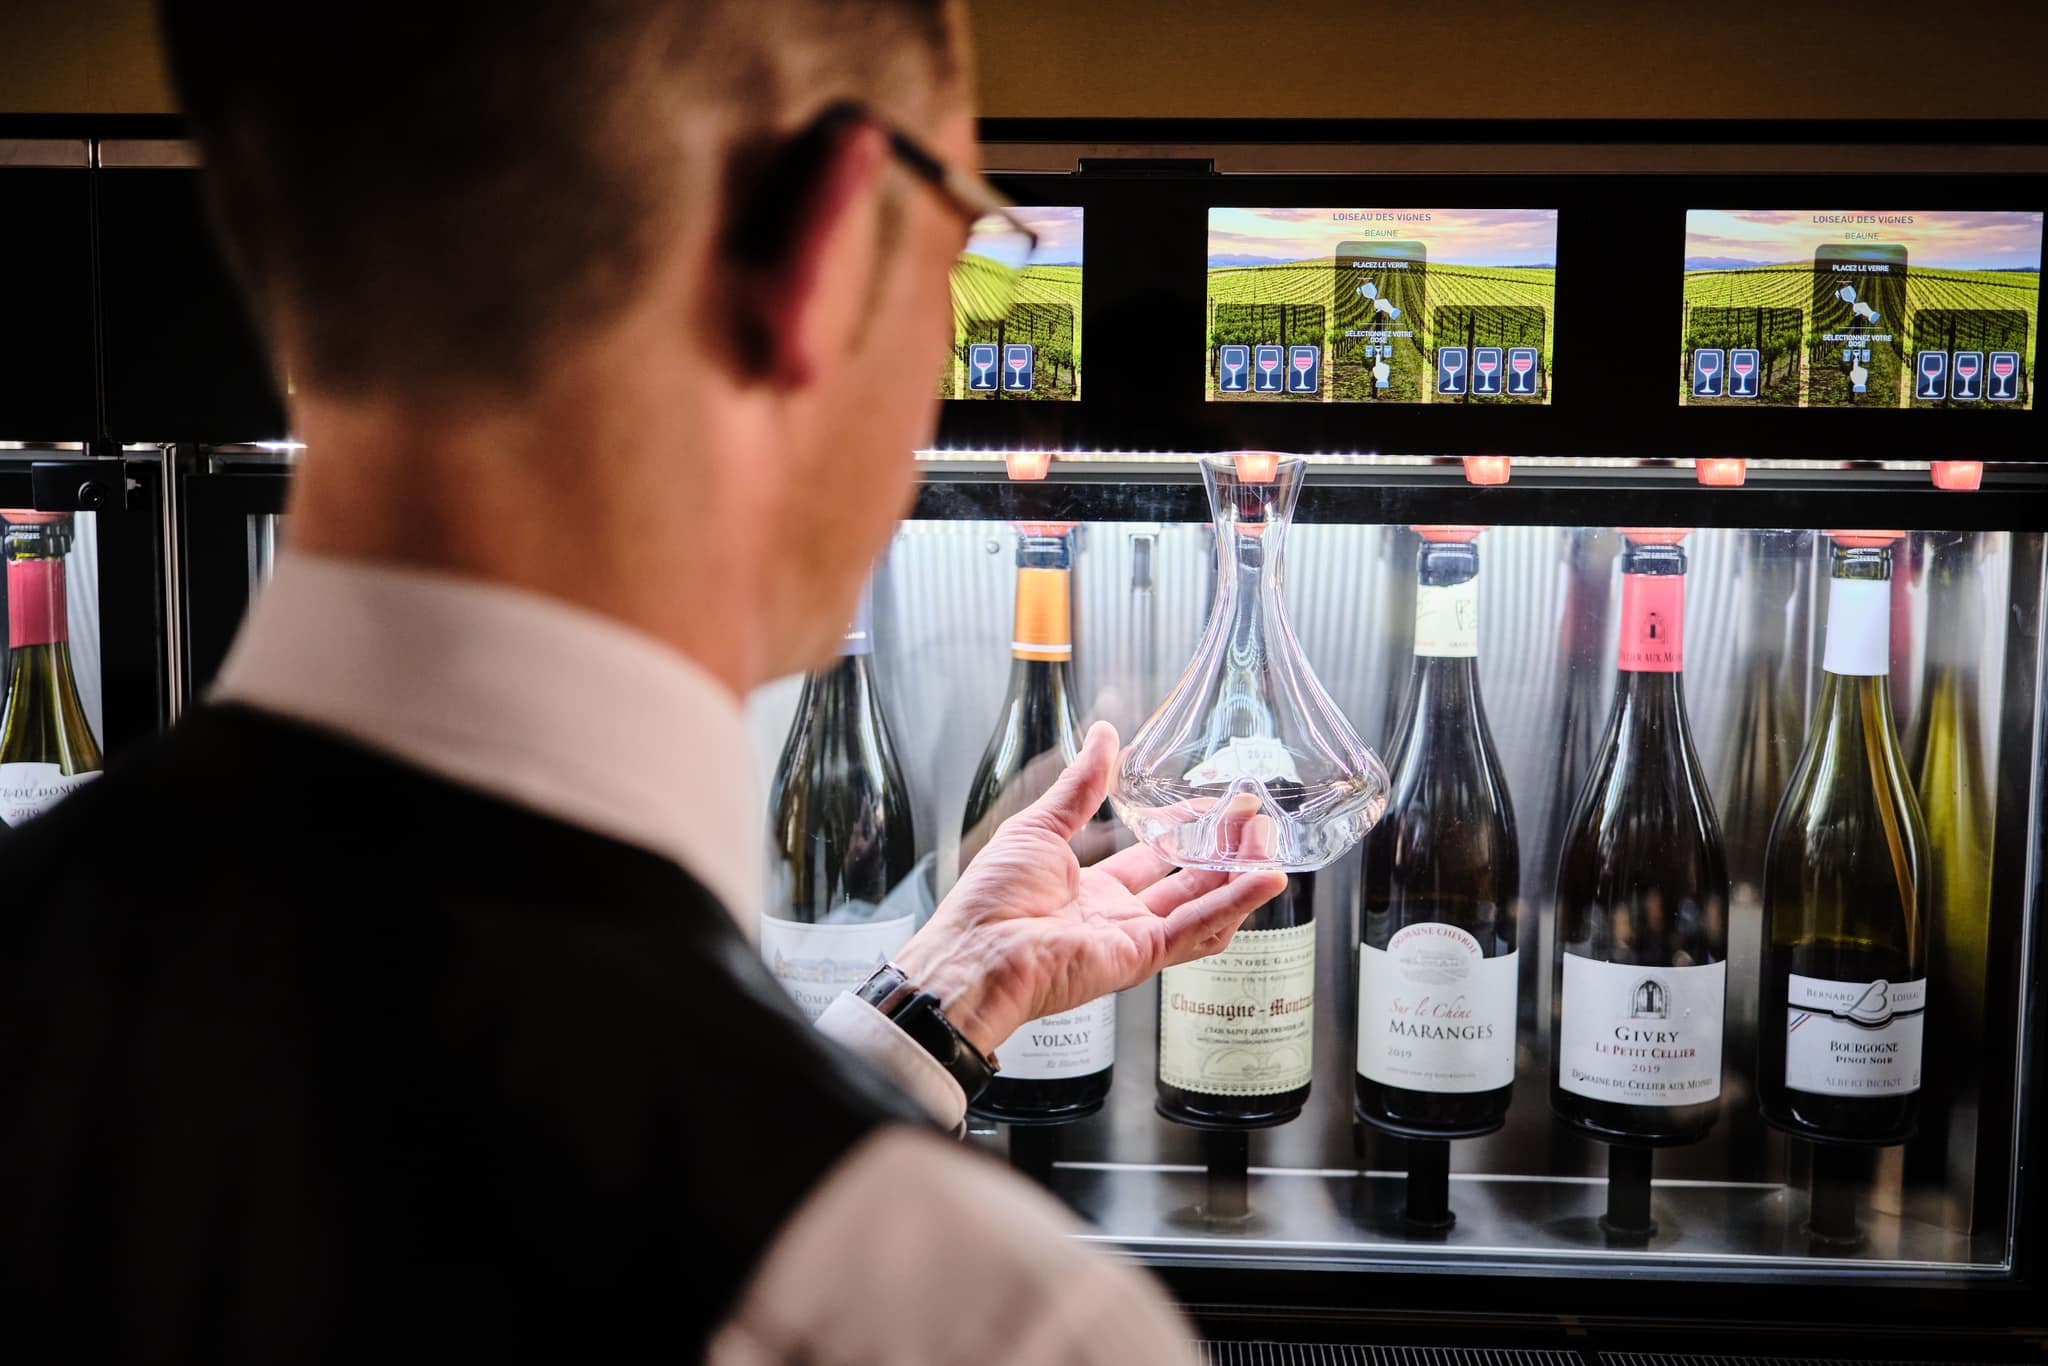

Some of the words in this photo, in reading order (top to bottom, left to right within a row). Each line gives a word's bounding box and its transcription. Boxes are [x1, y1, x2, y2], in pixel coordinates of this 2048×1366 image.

[1333, 212, 1373, 221] LOISEAU
[1375, 213, 1394, 221] DES
[1397, 213, 1431, 221] VIGNES
[1813, 215, 1853, 223] LOISEAU
[1878, 216, 1914, 224] VIGNES
[1365, 229, 1398, 237] BEAUNE
[1845, 232, 1879, 240] BEAUNE
[1353, 261, 1377, 269] PLACEZ
[1392, 926, 1434, 949] DOMAINE
[1436, 927, 1478, 953] CHEVROT
[1806, 987, 1854, 1002] BERNARD
[1390, 998, 1408, 1014] Sur
[1414, 996, 1430, 1017] le
[1389, 1019, 1494, 1041] MARANGES
[1615, 1026, 1679, 1043] GIVRY
[1032, 1030, 1091, 1047] VOLNAY
[1387, 1048, 1412, 1058] 2019
[1596, 1042, 1609, 1053] LE
[1613, 1045, 1647, 1057] PETIT
[1651, 1047, 1697, 1059] CELLIER
[1830, 1040, 1899, 1054] BOURGOGNE
[1836, 1055, 1867, 1065] PINOT
[1869, 1056, 1893, 1065] NOIR
[1632, 1063, 1661, 1073] 2019
[1572, 1068, 1610, 1086] DOMAINE
[1613, 1079, 1626, 1089] DU
[1628, 1080, 1666, 1091] CELLIER
[1668, 1080, 1685, 1090] AUX
